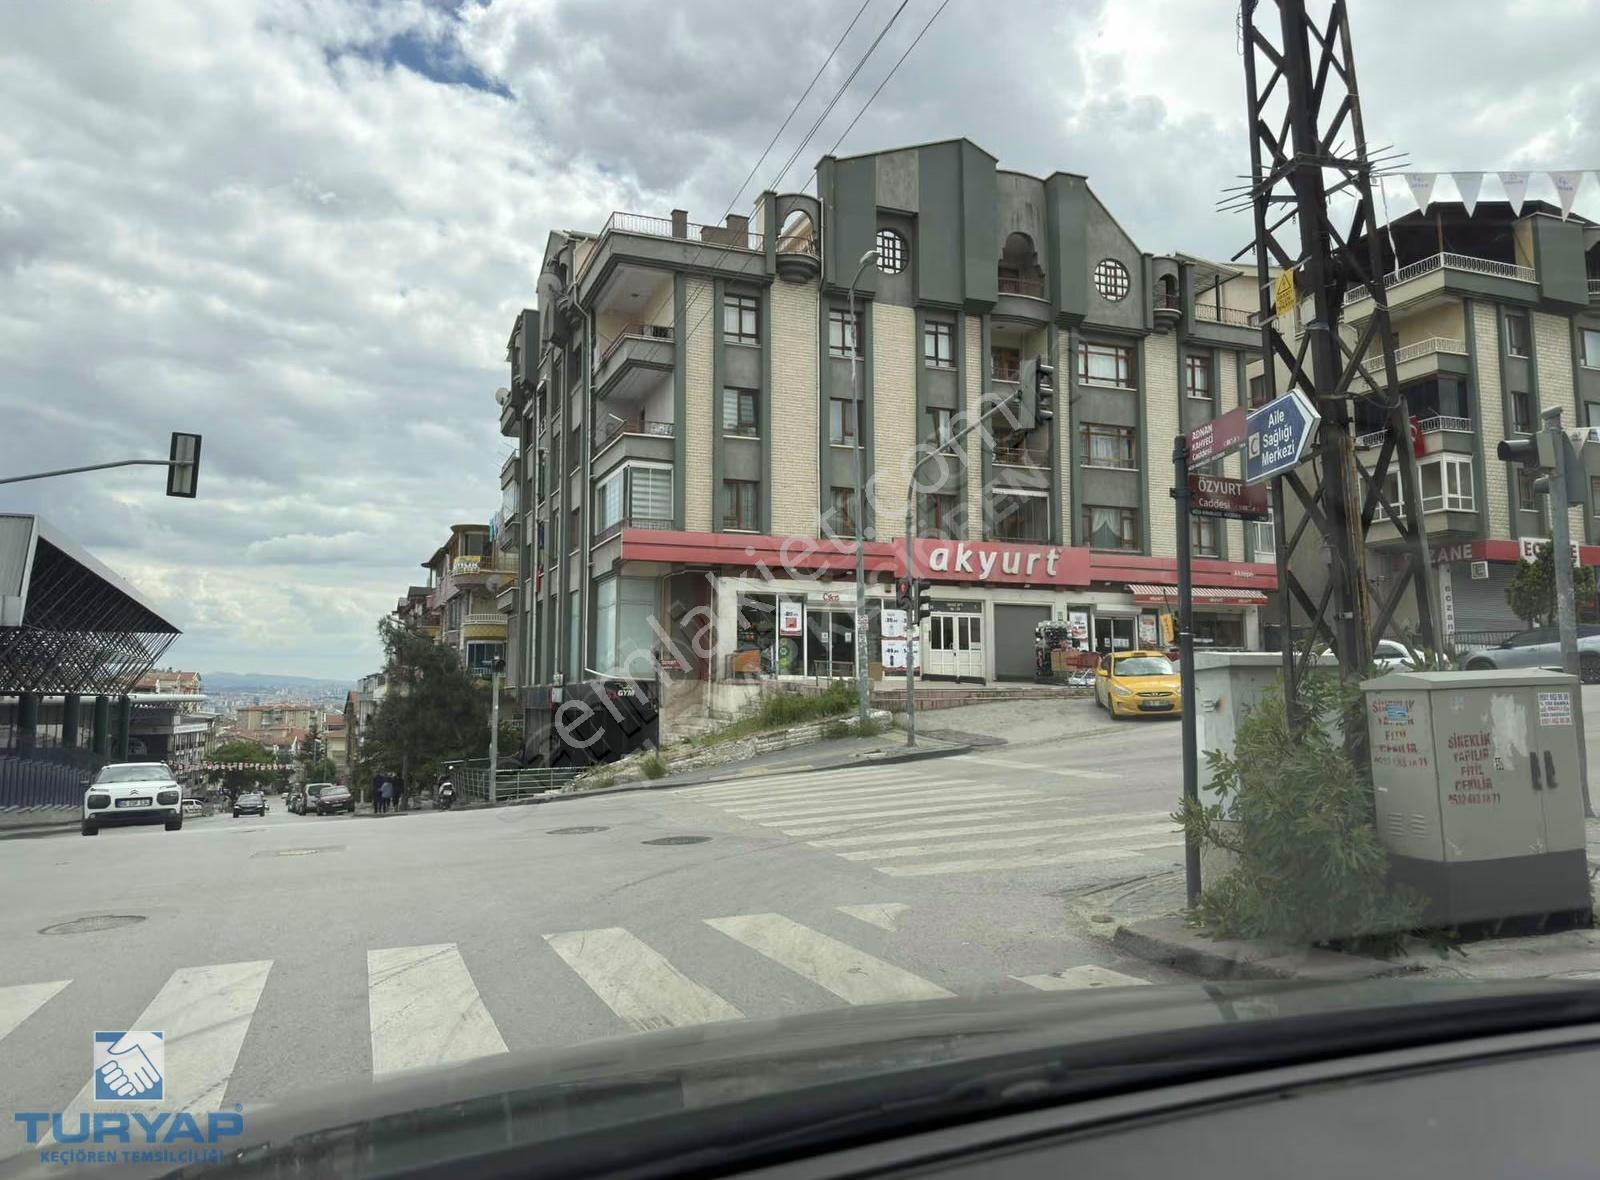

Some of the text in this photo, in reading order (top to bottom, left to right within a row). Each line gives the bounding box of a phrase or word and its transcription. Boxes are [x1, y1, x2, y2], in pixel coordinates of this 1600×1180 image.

[1268, 409, 1285, 428] Aile
[1191, 424, 1213, 441] ADNAN
[1262, 427, 1293, 448] Sağlığı
[1192, 448, 1213, 460] Caddesi
[1261, 441, 1295, 466] Merkezi
[1198, 477, 1243, 496] ÖZYURT
[1198, 497, 1231, 510] Caddesi
[929, 542, 1061, 583] akyurt
[617, 689, 635, 697] GYM
